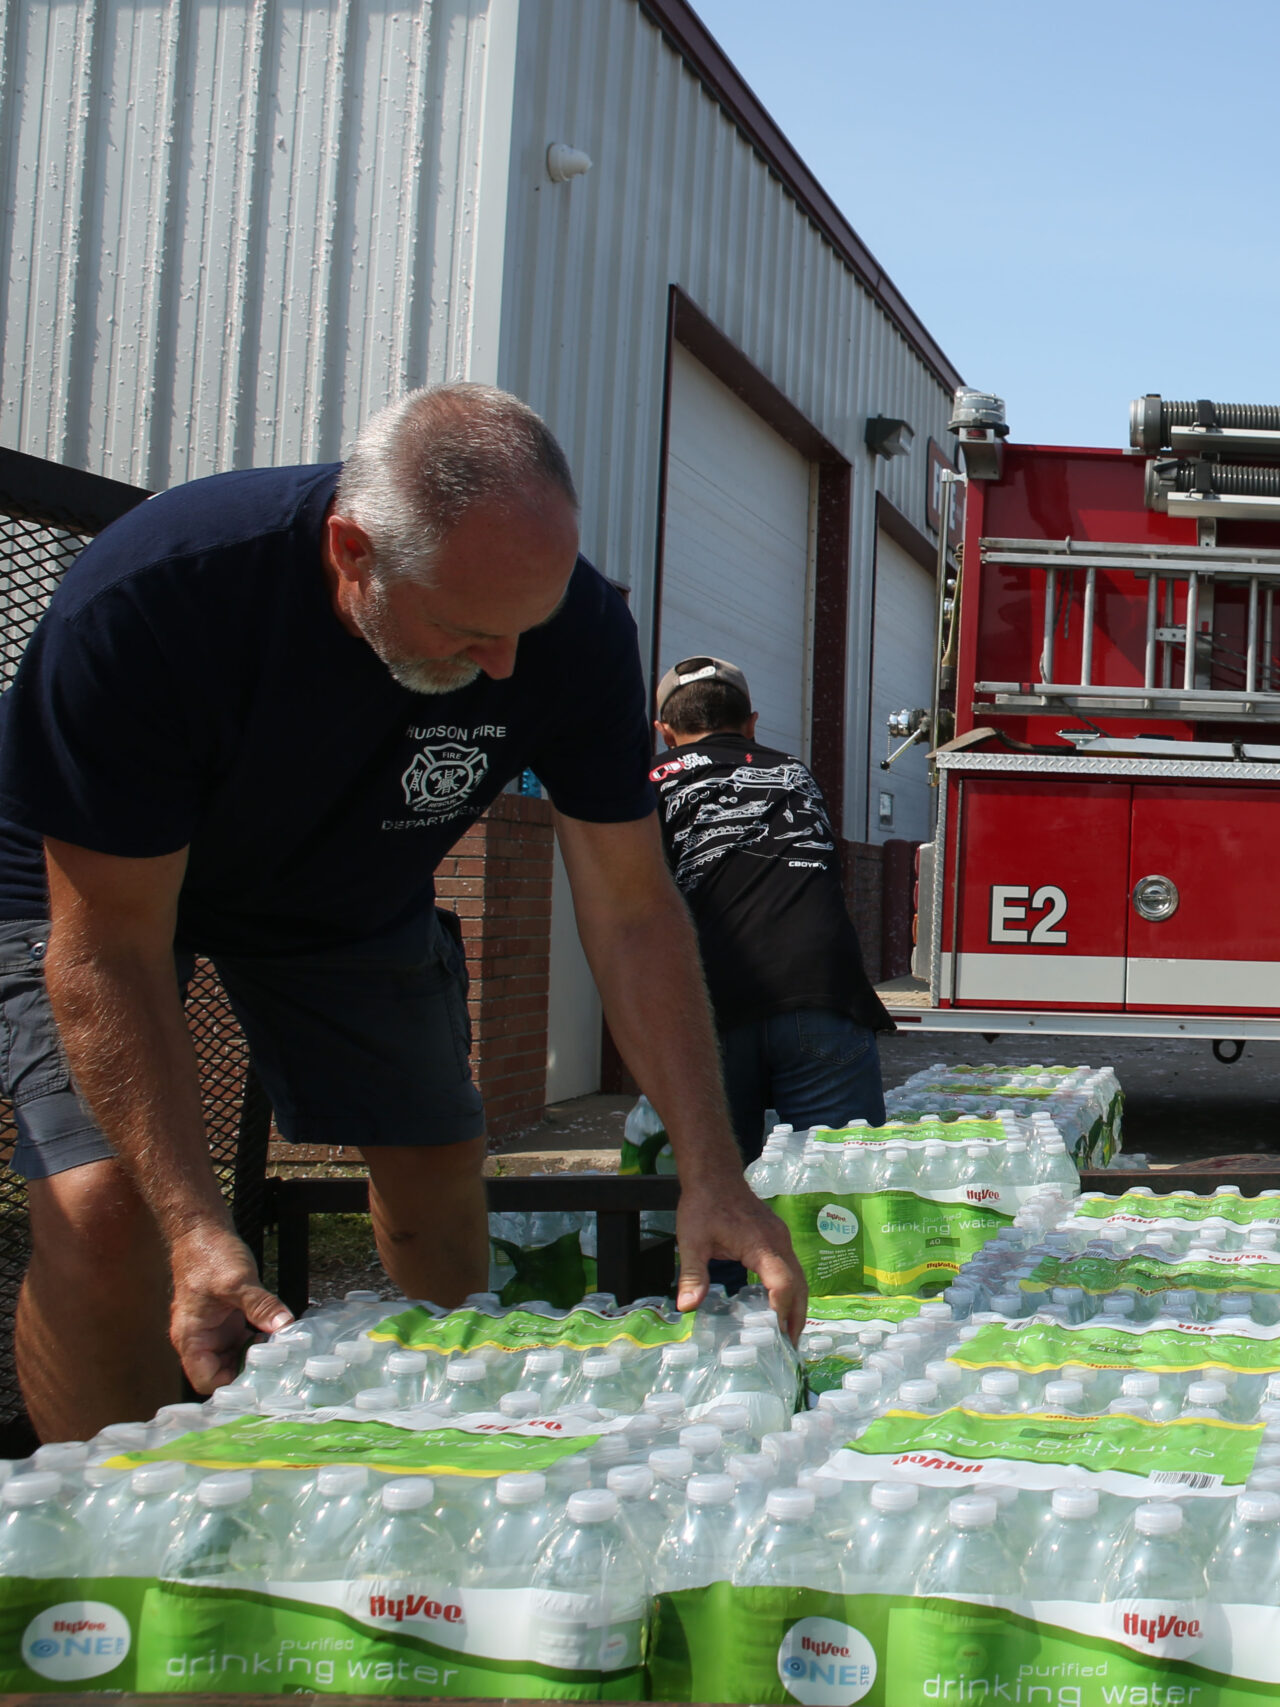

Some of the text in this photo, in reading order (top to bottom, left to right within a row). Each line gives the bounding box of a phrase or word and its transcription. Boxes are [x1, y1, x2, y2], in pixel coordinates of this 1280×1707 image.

[405, 725, 506, 740] HUDSON FIRE
[988, 885, 1068, 946] E2
[966, 1190, 1000, 1202] HyVee
[881, 1221, 951, 1236] drinking
[369, 1594, 464, 1623] HyVee
[53, 1620, 107, 1634] HyVee
[1123, 1613, 1201, 1643] HyVee
[30, 1637, 113, 1658] ONE
[281, 1637, 354, 1653] purified
[802, 1636, 851, 1658] HyVee
[166, 1649, 459, 1686] drinking water
[783, 1656, 857, 1686] ONE
[1019, 1661, 1108, 1678] purified
[923, 1673, 1201, 1707] drinking water
